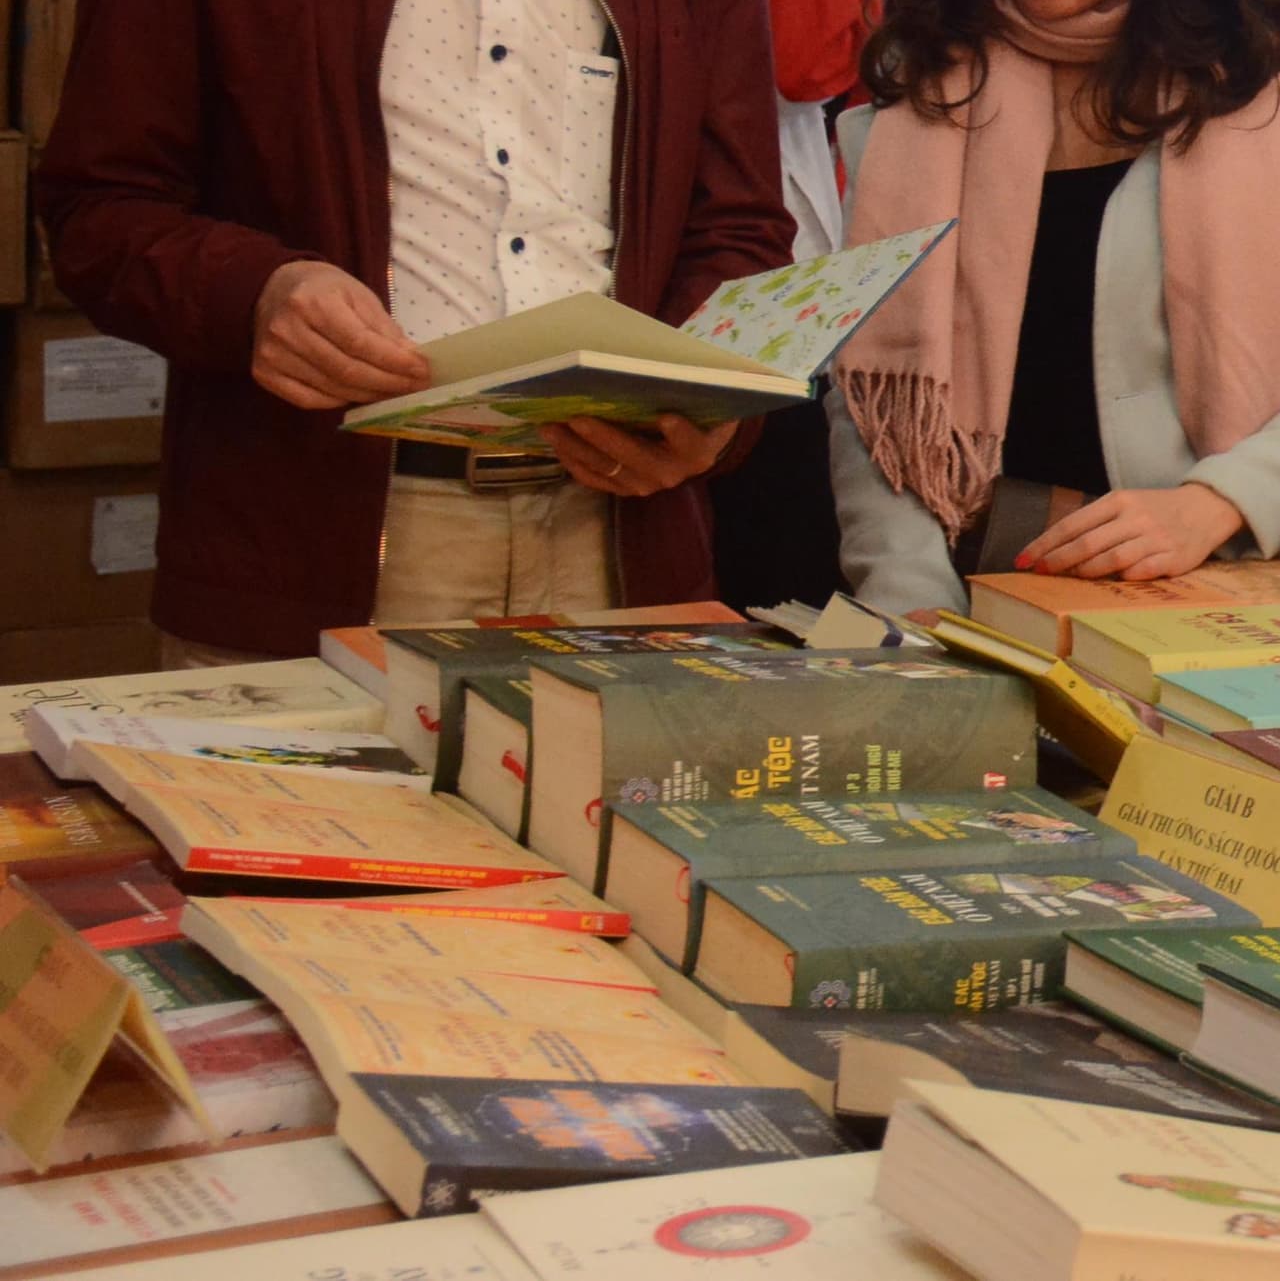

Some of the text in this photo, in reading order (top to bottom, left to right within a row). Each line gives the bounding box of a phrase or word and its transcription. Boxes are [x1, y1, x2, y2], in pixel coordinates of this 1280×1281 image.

[763, 737, 794, 787] TỘC
[802, 735, 819, 778] NAM
[1242, 797, 1256, 819] B
[1215, 872, 1244, 896] HAI
